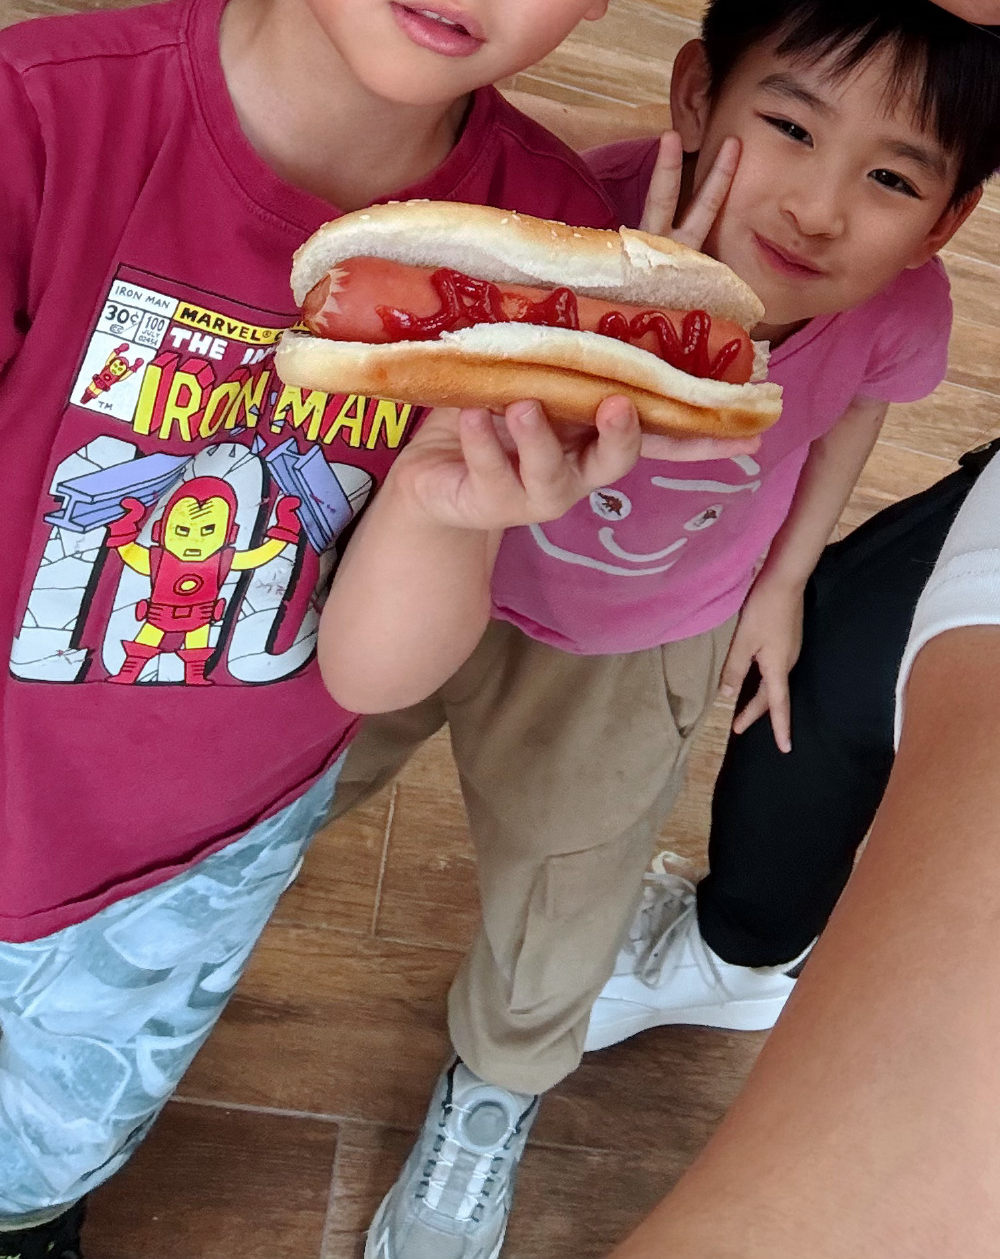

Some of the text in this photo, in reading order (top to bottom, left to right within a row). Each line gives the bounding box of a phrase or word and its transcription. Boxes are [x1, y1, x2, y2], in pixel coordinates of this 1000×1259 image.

[115, 285, 171, 309] IRON MAN
[142, 329, 161, 338] JULY
[145, 316, 165, 332] 100
[170, 327, 228, 360] THE
[98, 400, 114, 411] TM
[132, 352, 412, 450] IRON MAN
